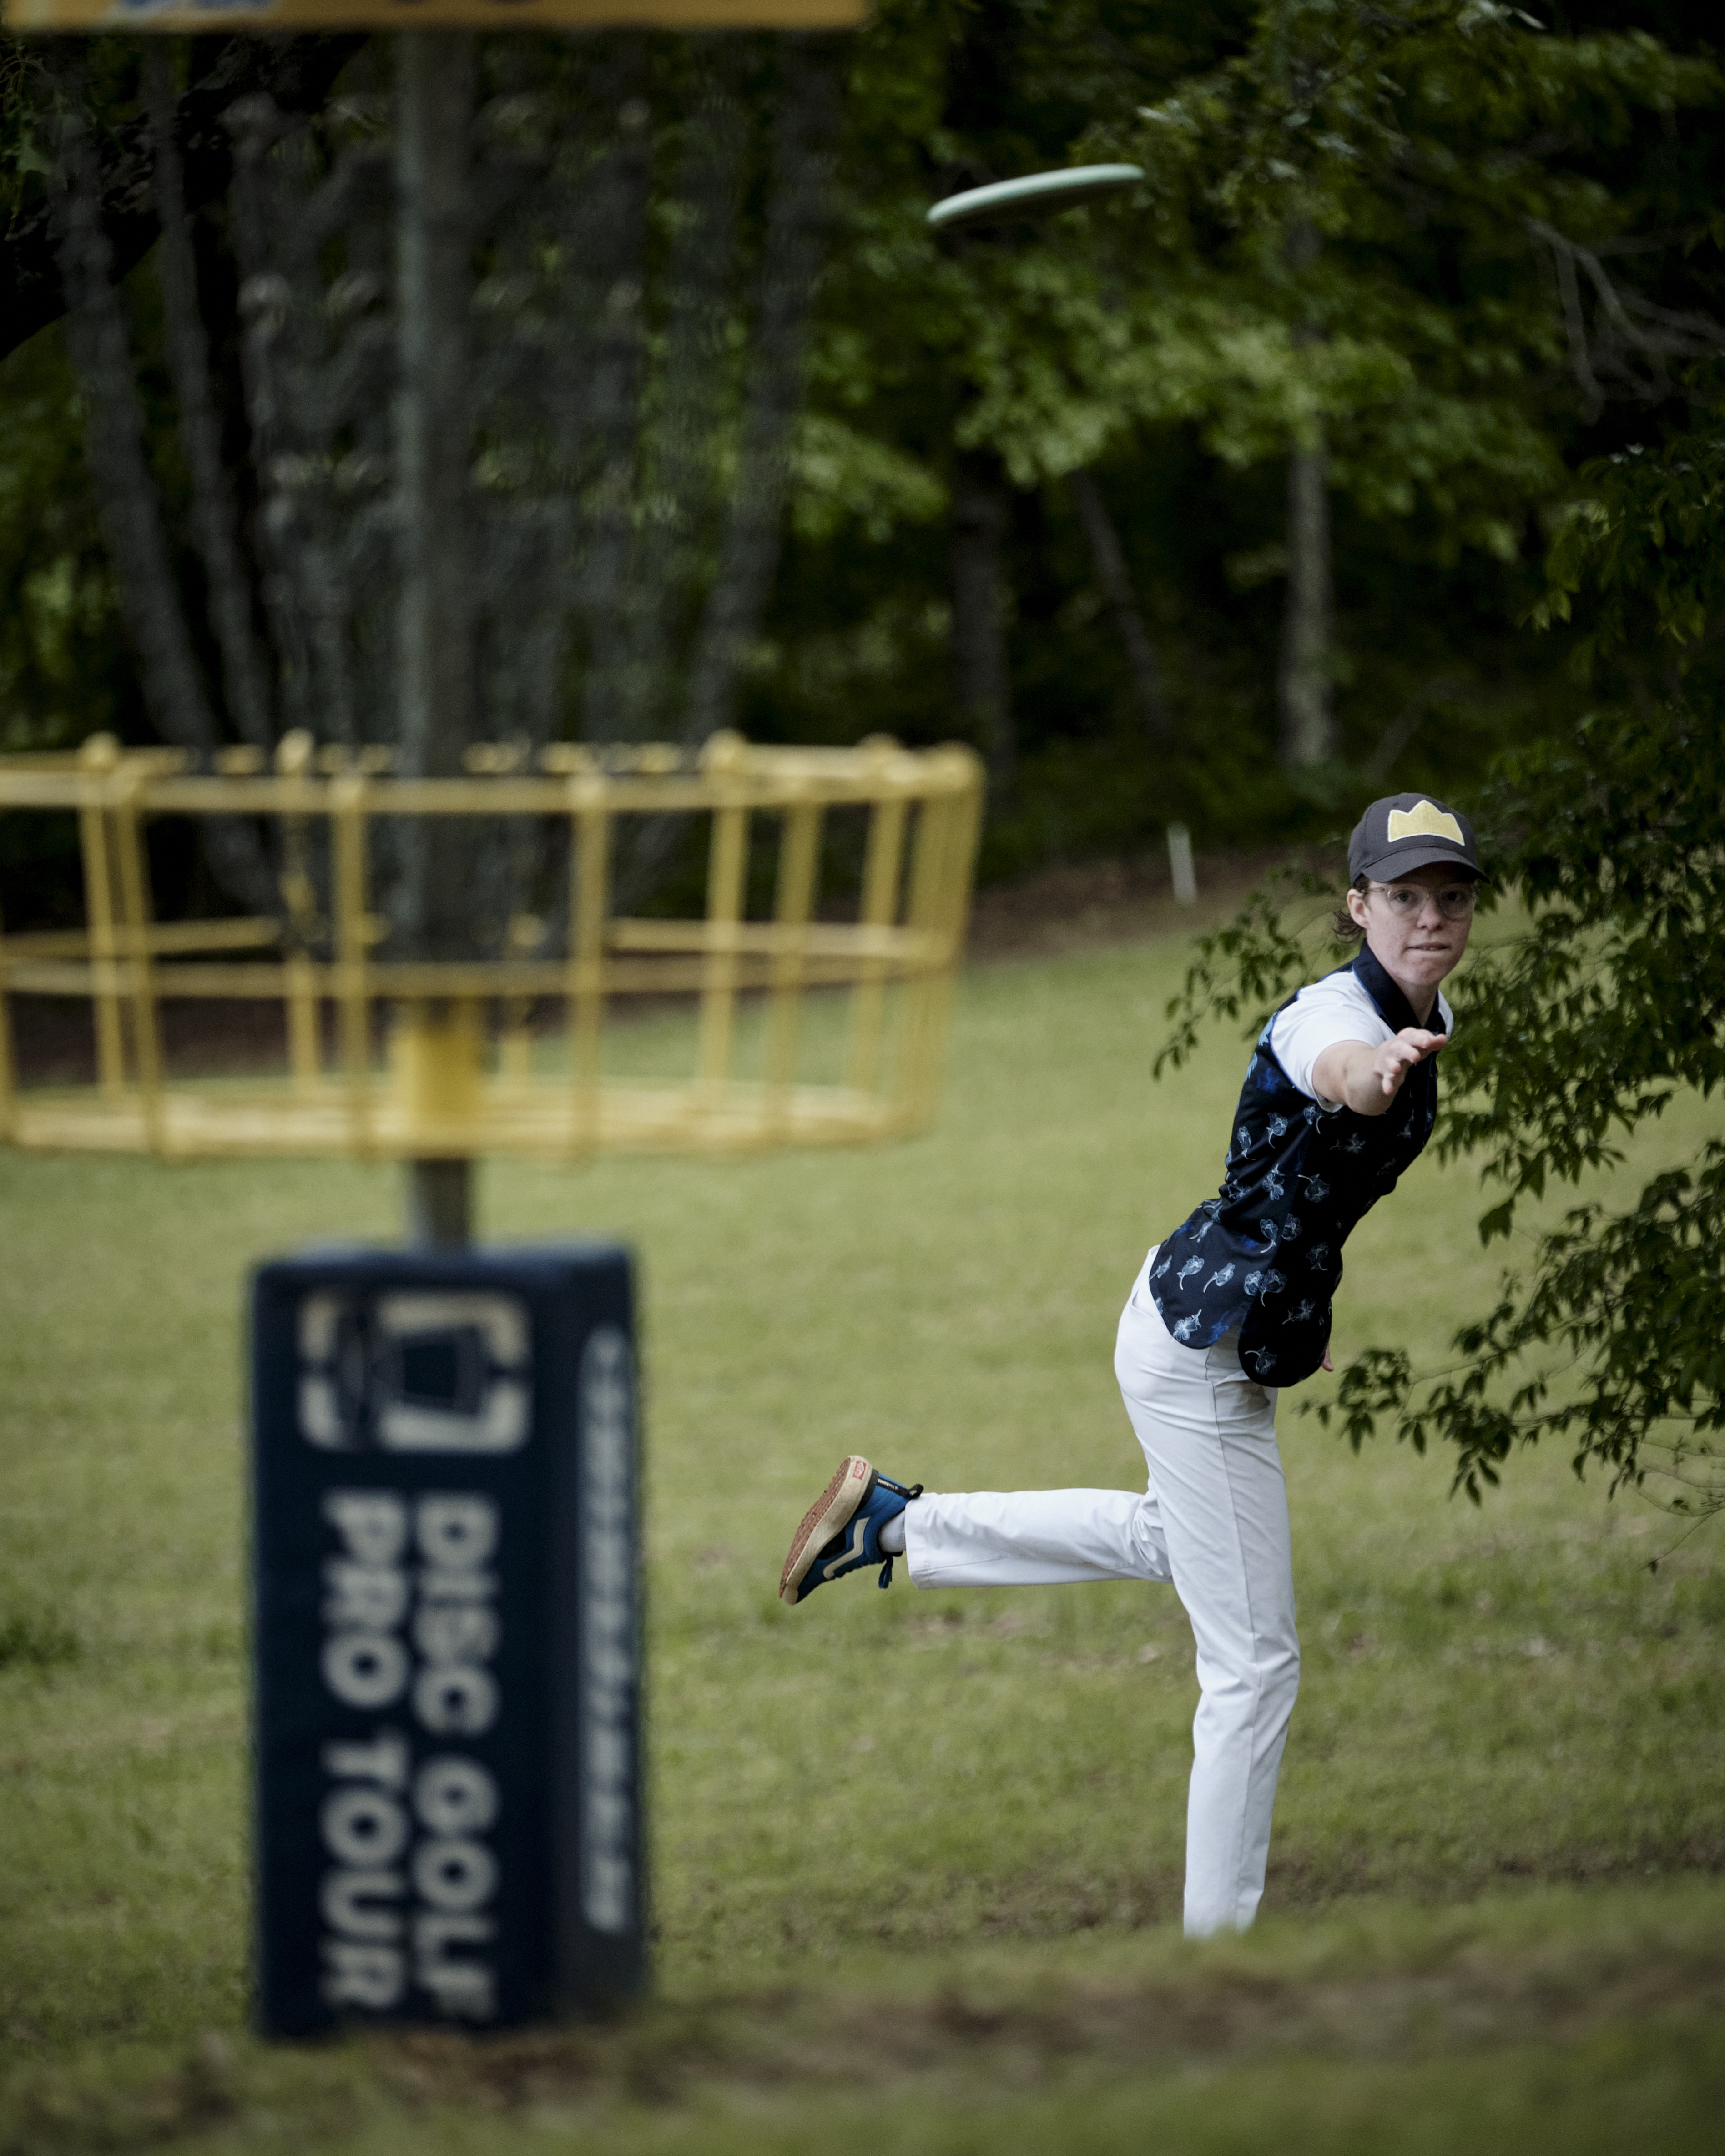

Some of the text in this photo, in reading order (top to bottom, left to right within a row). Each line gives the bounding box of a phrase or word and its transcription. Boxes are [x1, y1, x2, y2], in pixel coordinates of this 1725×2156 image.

[320, 1489, 410, 2009] PRO TOUR
[413, 1494, 500, 2020] DISC GOLF
